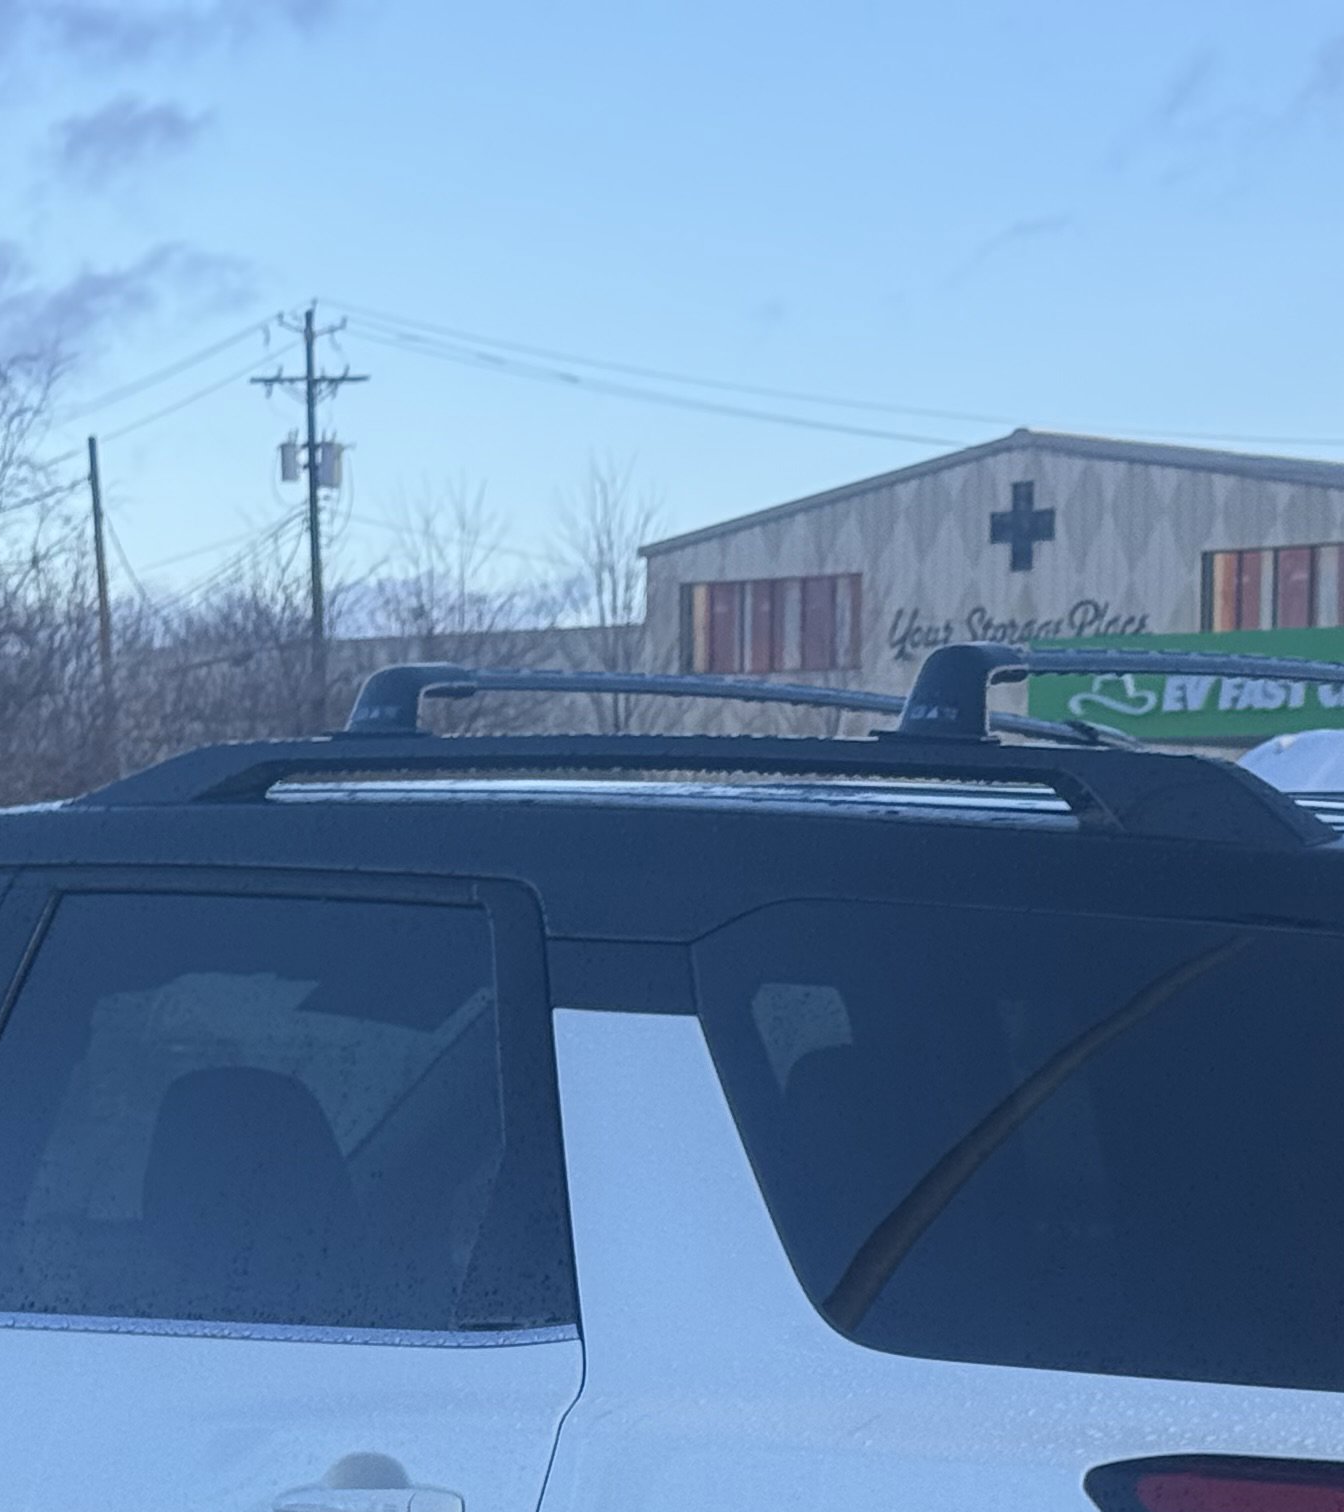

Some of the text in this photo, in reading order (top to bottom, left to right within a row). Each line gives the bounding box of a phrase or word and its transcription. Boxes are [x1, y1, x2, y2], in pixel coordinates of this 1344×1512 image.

[887, 605, 955, 661] Your
[1161, 674, 1218, 713] EV
[1218, 676, 1308, 711] FAST
